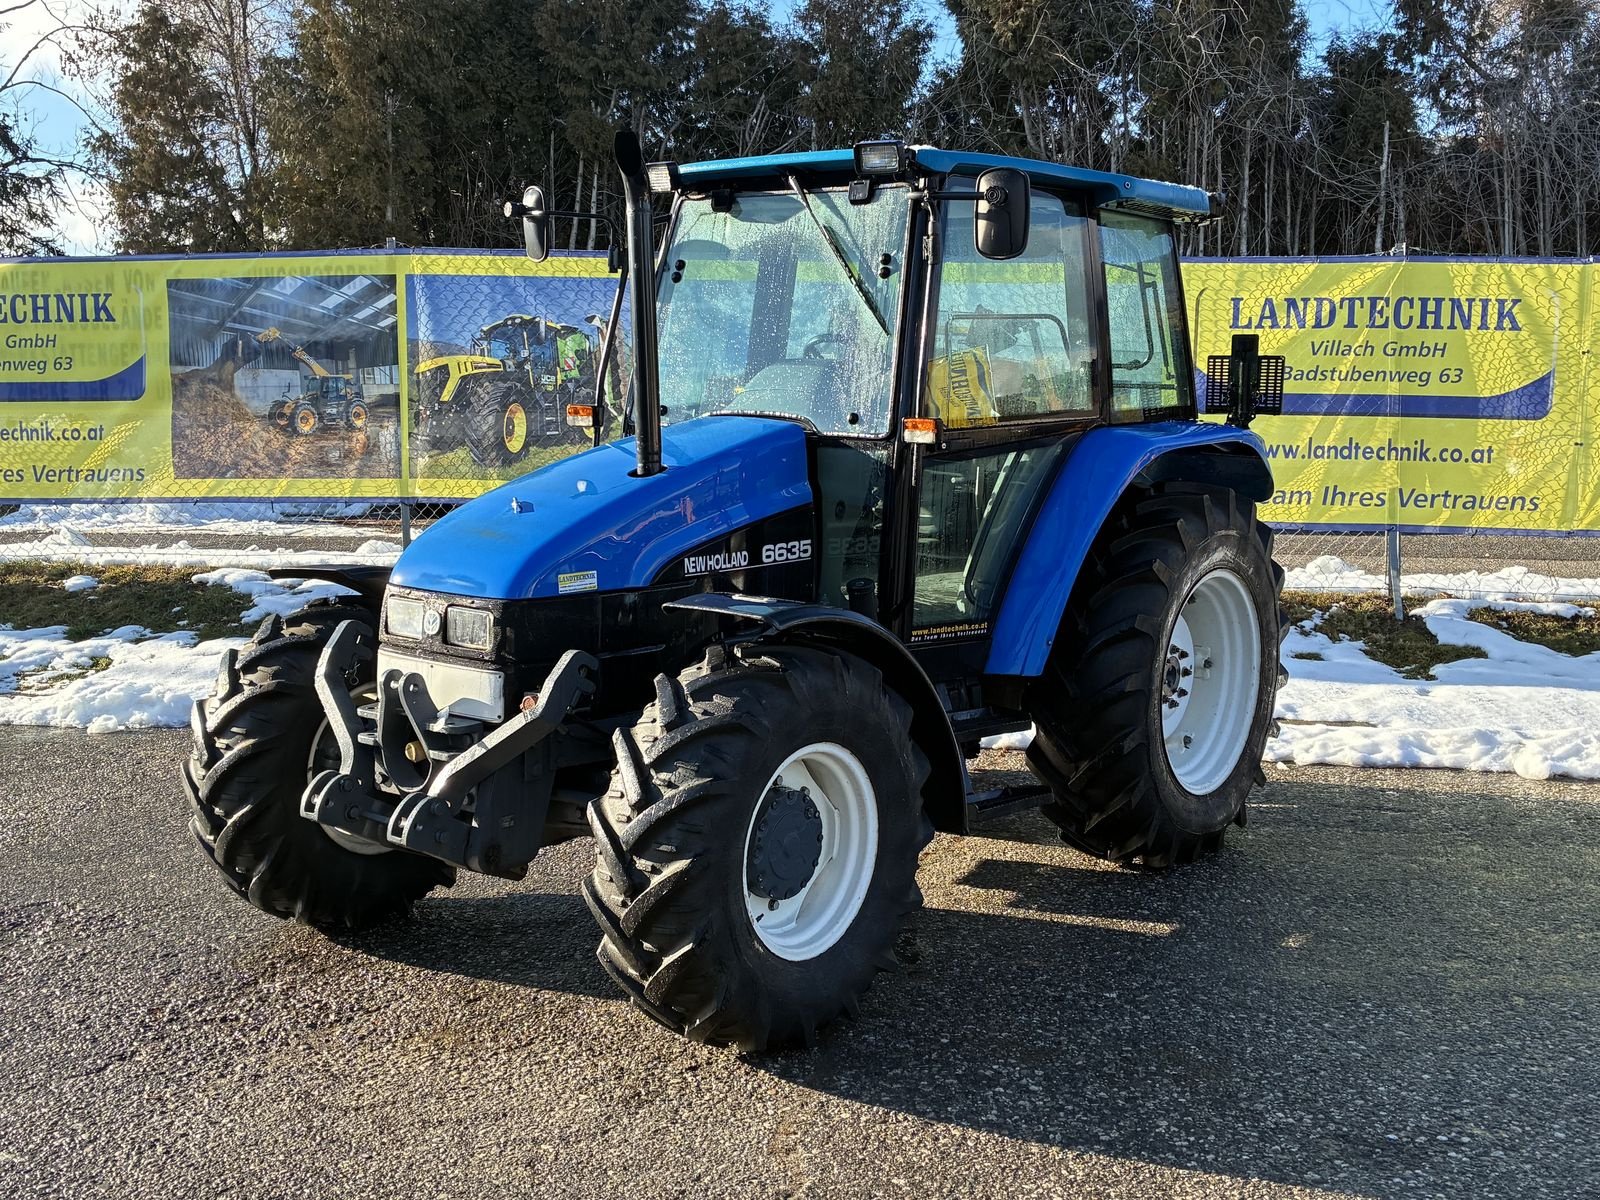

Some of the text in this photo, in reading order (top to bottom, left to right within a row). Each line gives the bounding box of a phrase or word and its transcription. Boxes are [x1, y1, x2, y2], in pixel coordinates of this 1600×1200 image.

[1229, 296, 1523, 332] LANDTECHNIK
[5, 333, 57, 349] GmbH
[1310, 340, 1447, 358] Villach GmbH
[0, 356, 73, 375] nweg 63
[1281, 364, 1464, 387] Badstubenweg 63
[0, 420, 104, 441] echnik.co.at
[0, 464, 146, 483] es Vertrauens
[1261, 485, 1541, 512] am Ihres Vertrauens
[684, 539, 812, 574] NEW HOLLAND 6635
[911, 622, 988, 636] www.landtechnik.co.at
